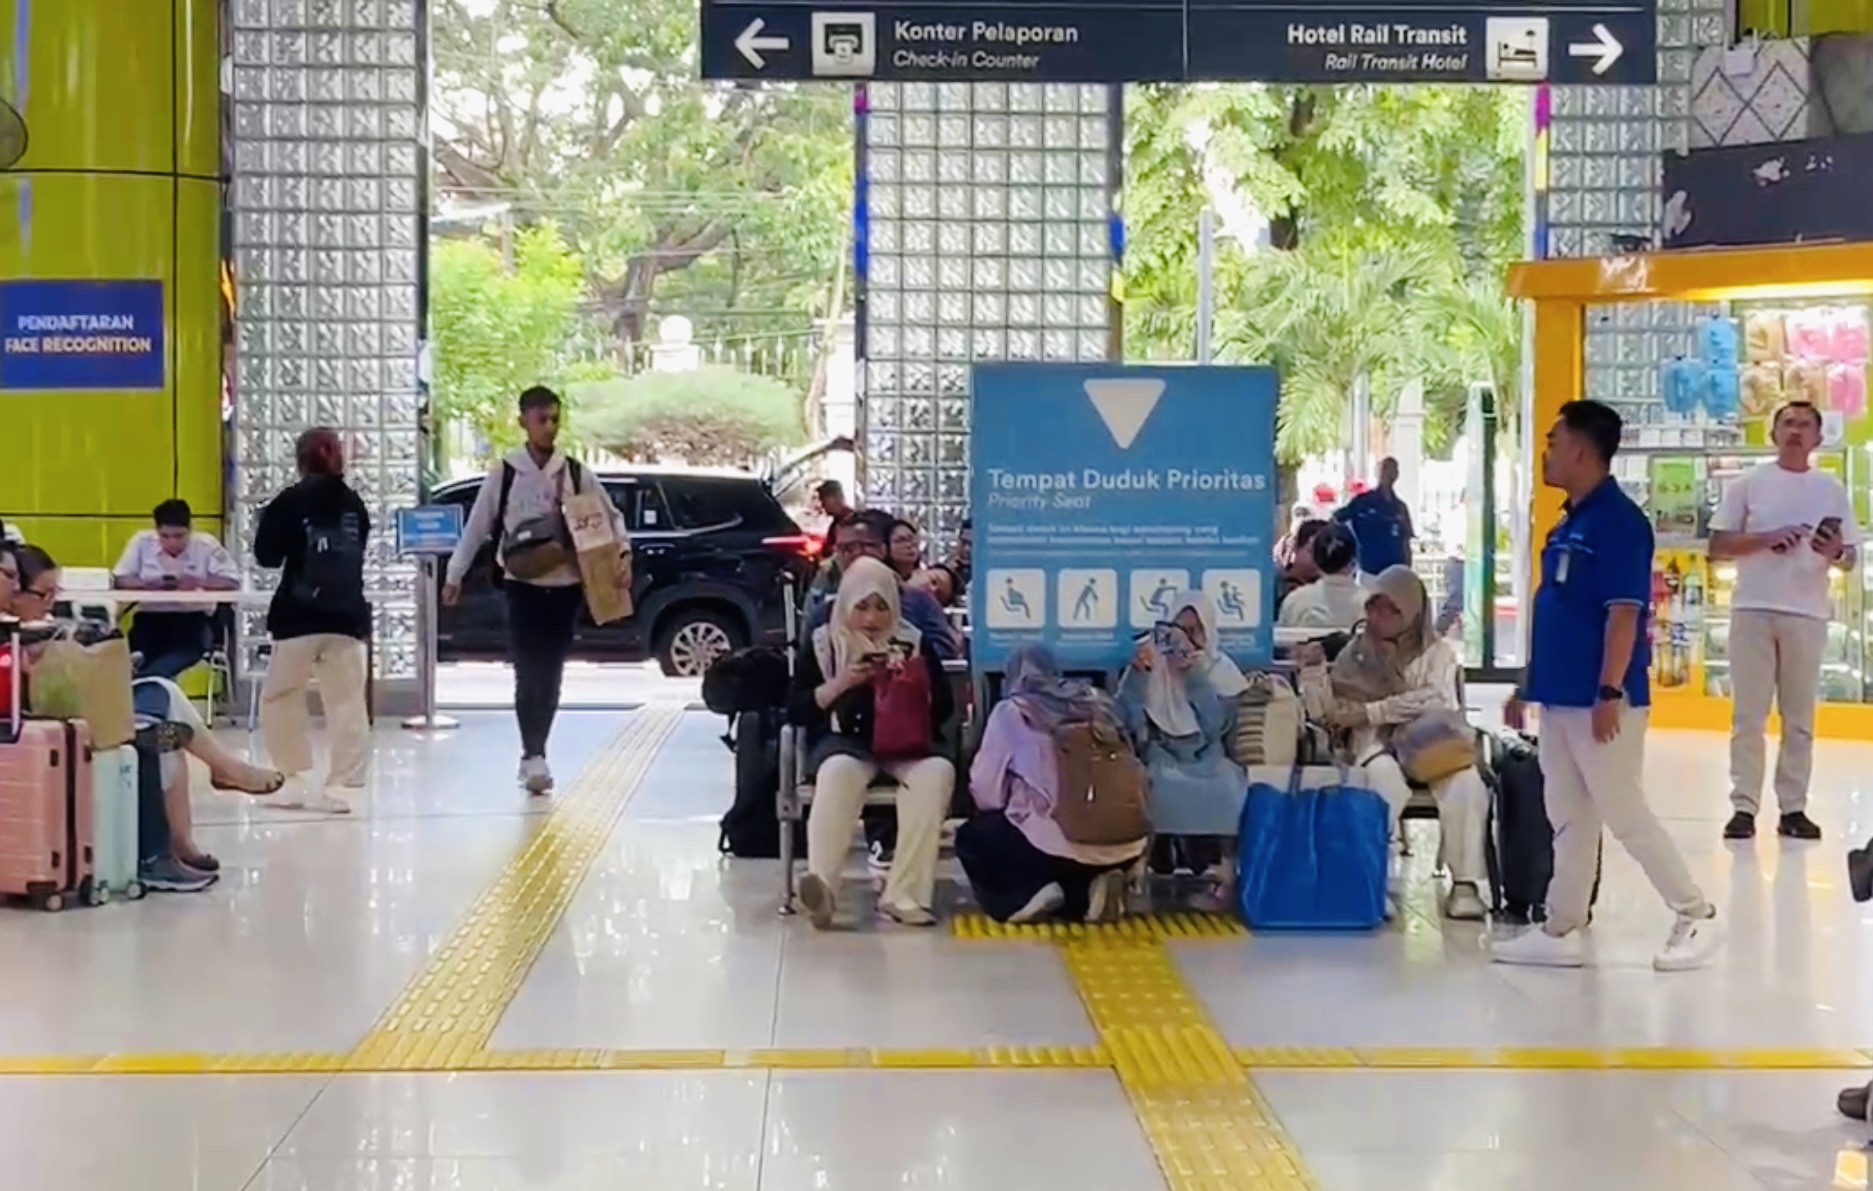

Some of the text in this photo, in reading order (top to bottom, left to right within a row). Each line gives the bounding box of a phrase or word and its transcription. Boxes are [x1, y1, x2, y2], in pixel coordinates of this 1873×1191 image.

[894, 21, 1079, 46] Konter Pelaporan
[1287, 23, 1468, 45] Hotel Rail Transit
[892, 50, 1041, 68] Check-in Counter
[1324, 53, 1469, 71] Rail Transit Hotel
[17, 314, 134, 331] PENDAFTARAN
[4, 336, 152, 353] FACE RECOGNITION
[987, 468, 1266, 494] Tempat Duduk Prioritas
[987, 493, 1048, 511] Priority
